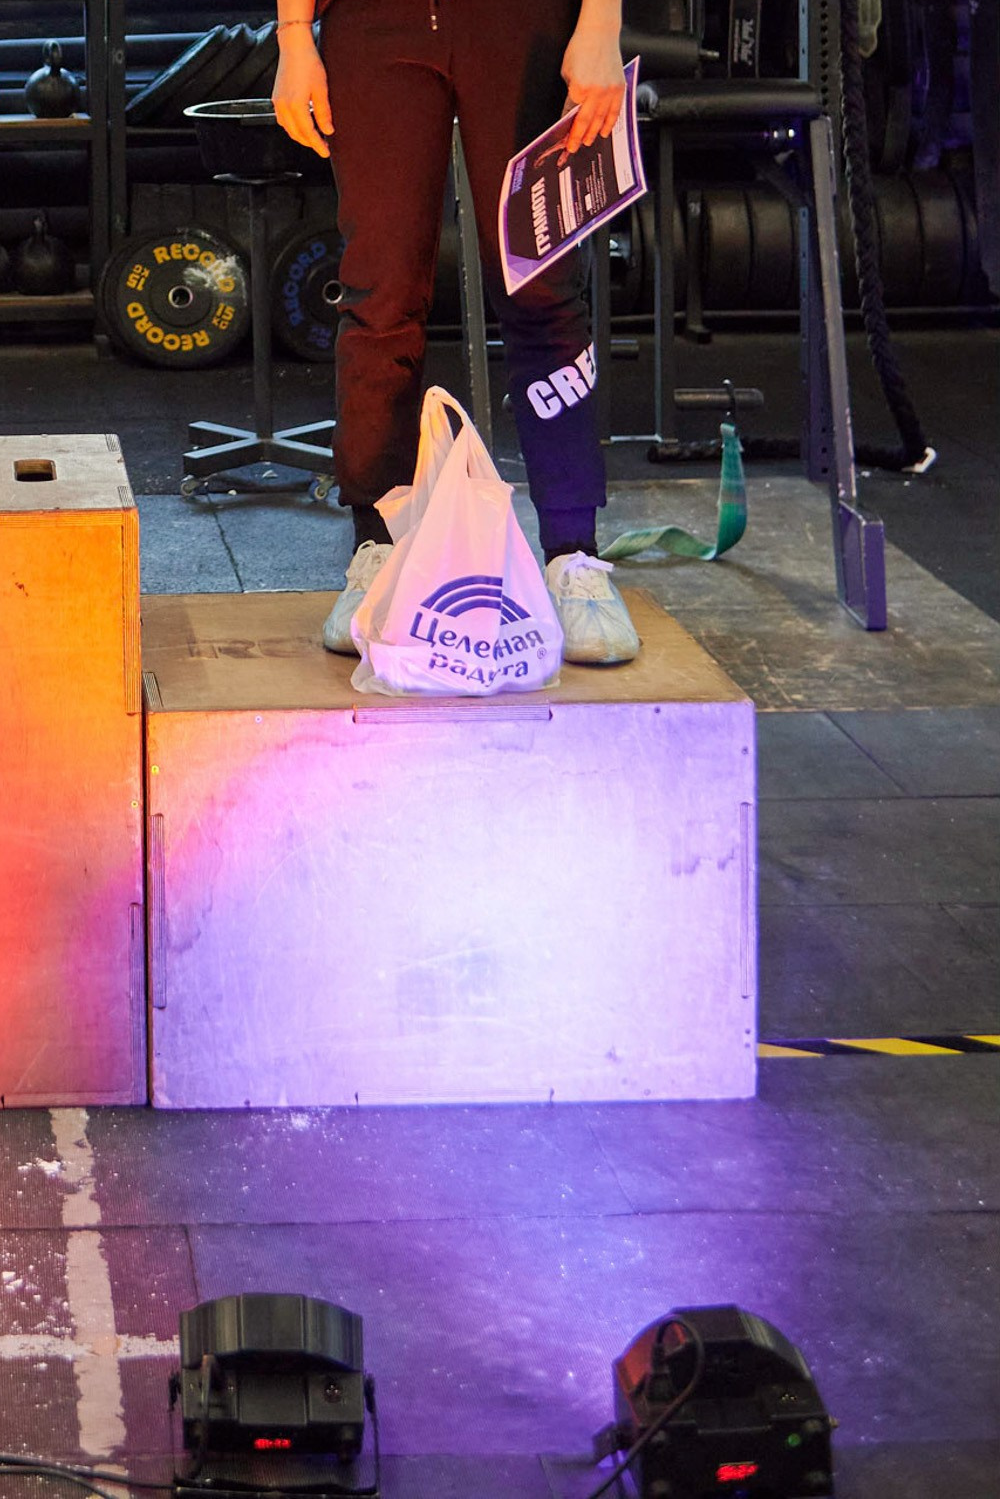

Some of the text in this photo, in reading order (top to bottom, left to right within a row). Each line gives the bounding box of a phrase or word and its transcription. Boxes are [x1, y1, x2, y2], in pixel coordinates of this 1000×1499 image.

[530, 176, 551, 257] ГРАМОТА
[126, 302, 211, 351] RECORD
[212, 316, 229, 331] KG
[216, 303, 235, 321] 15
[526, 340, 598, 420] CRE
[409, 611, 544, 661] Целеная
[428, 651, 529, 688] радуга
